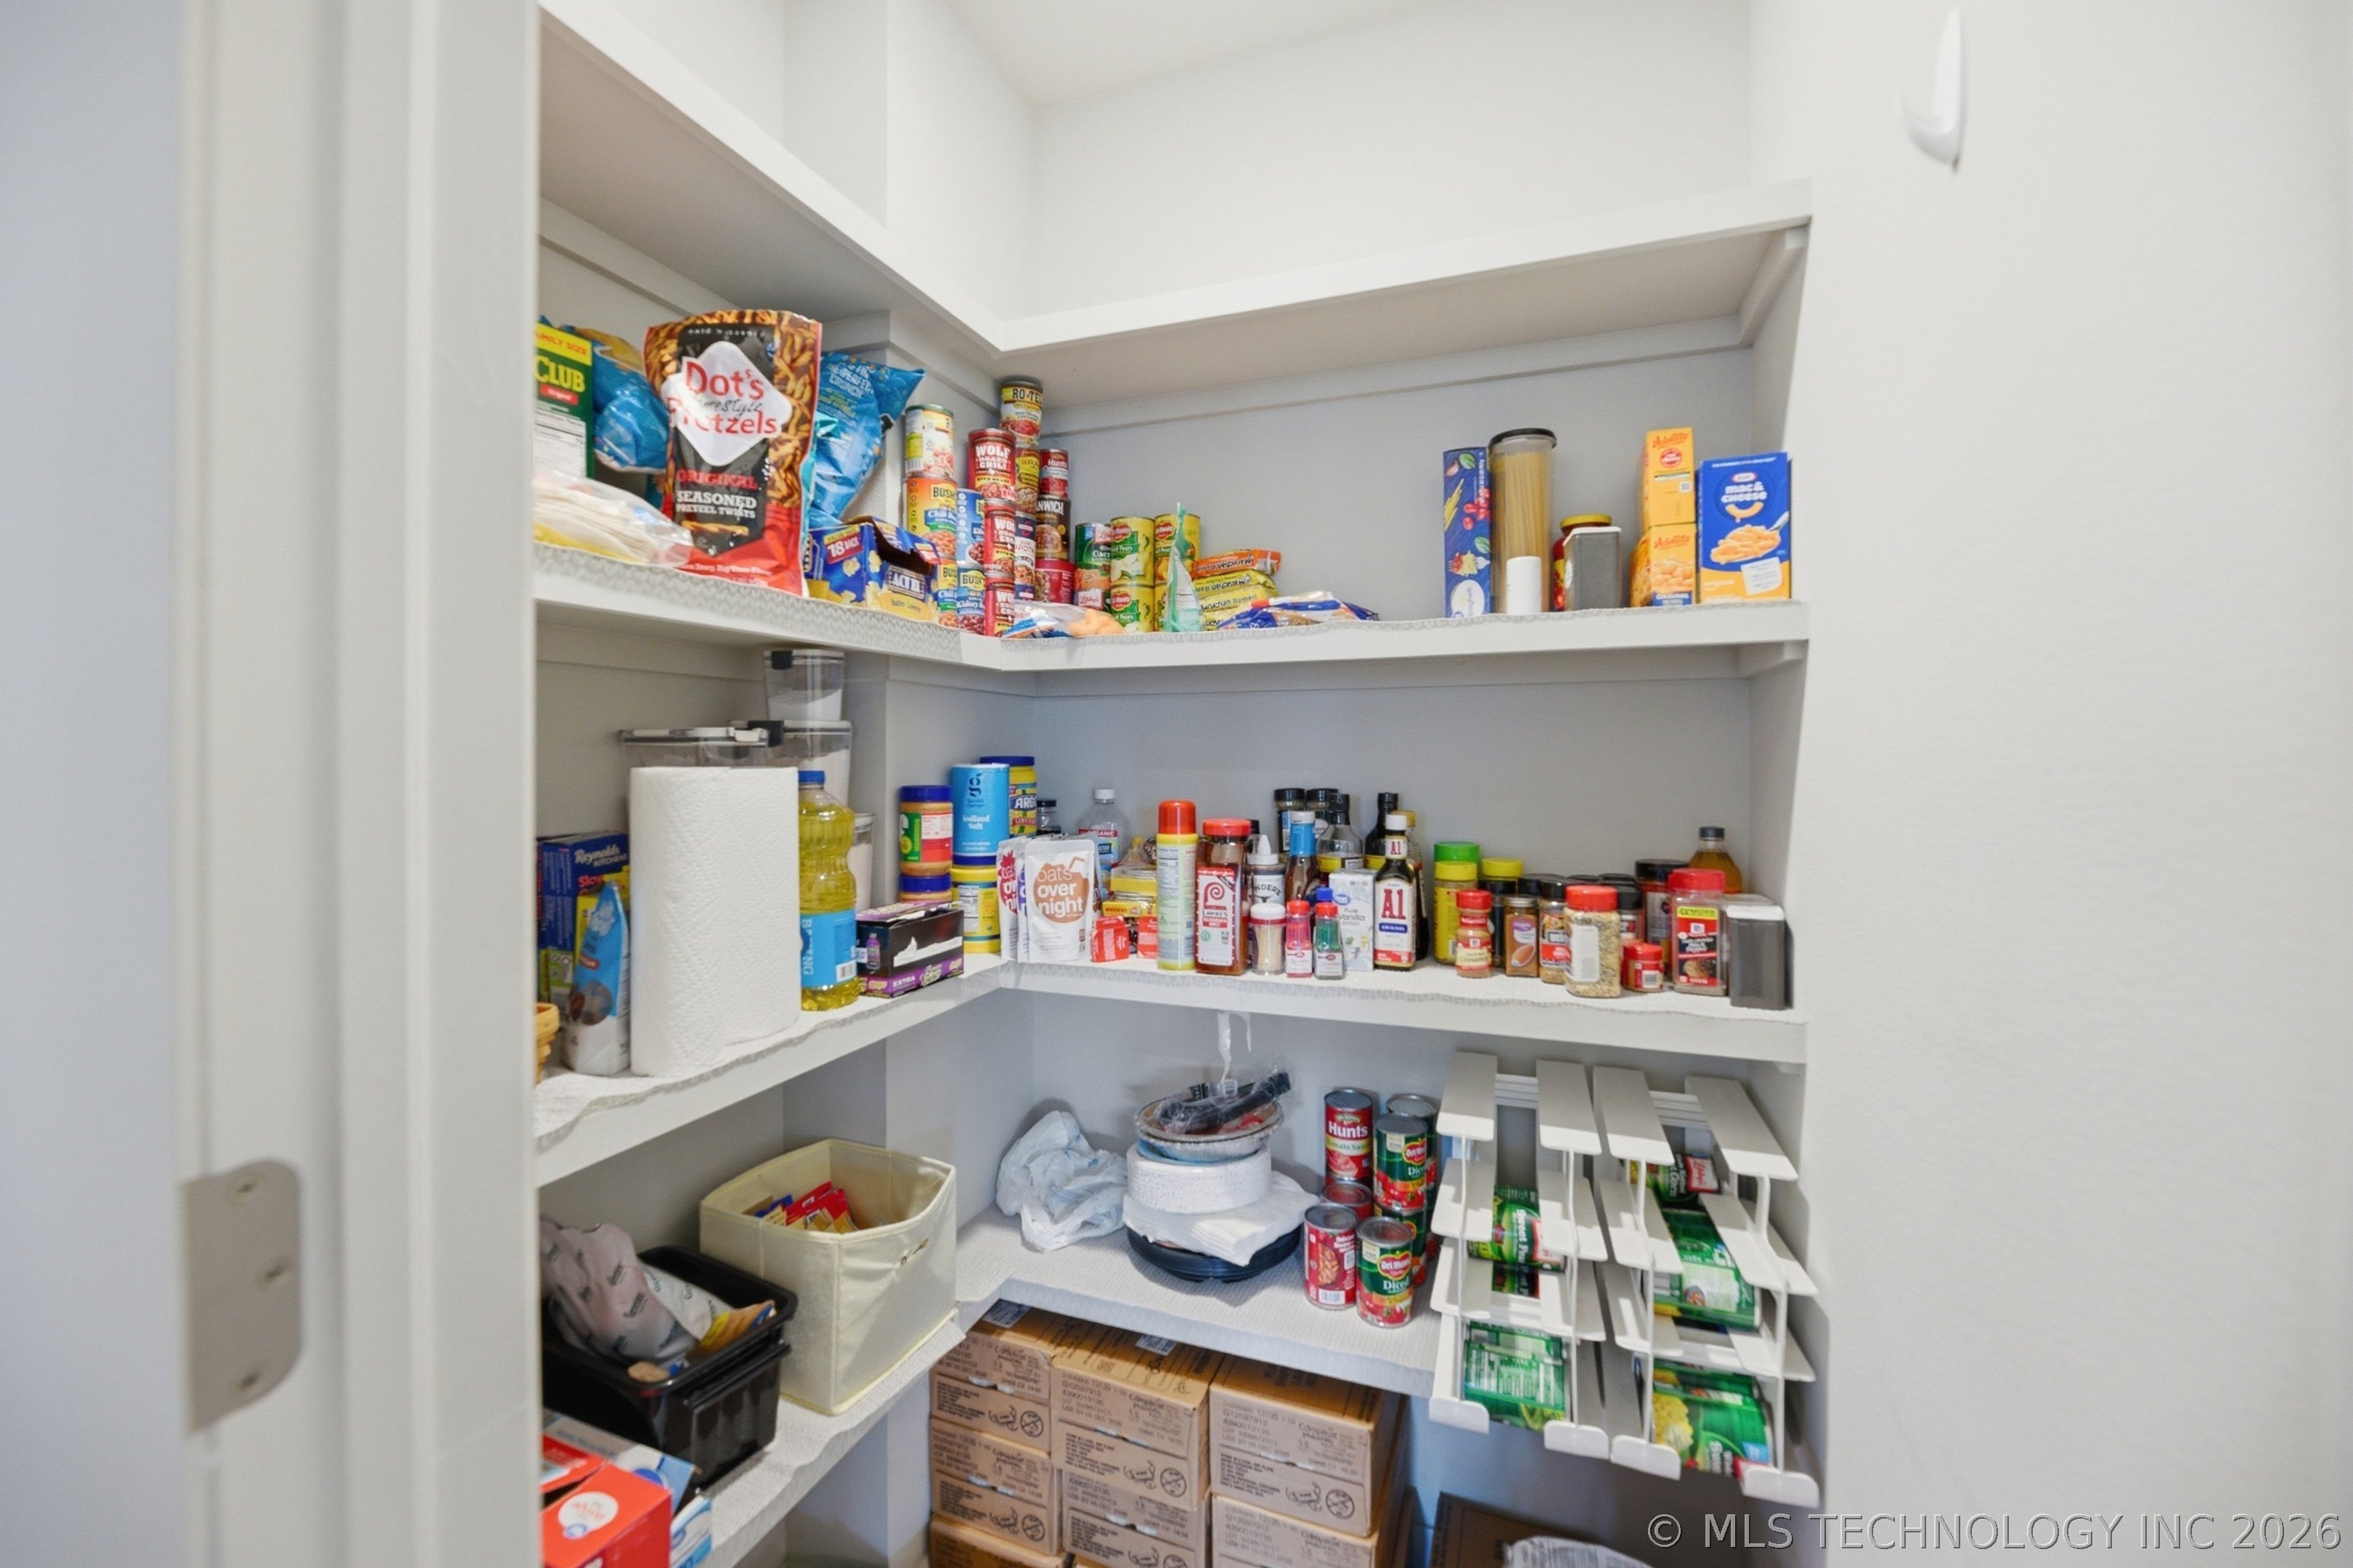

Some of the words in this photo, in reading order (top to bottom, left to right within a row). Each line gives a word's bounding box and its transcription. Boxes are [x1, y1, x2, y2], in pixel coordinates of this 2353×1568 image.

[534, 354, 586, 393] CLUB
[686, 360, 765, 401] Dot's
[667, 397, 778, 435] Ptzels
[975, 444, 1011, 460] WOLF
[677, 469, 759, 491] ORIGINAL
[677, 491, 758, 510] SEASONED
[574, 844, 621, 865] Reynolds
[1037, 865, 1074, 883] oats
[1037, 881, 1078, 899] over
[1038, 896, 1085, 919] night
